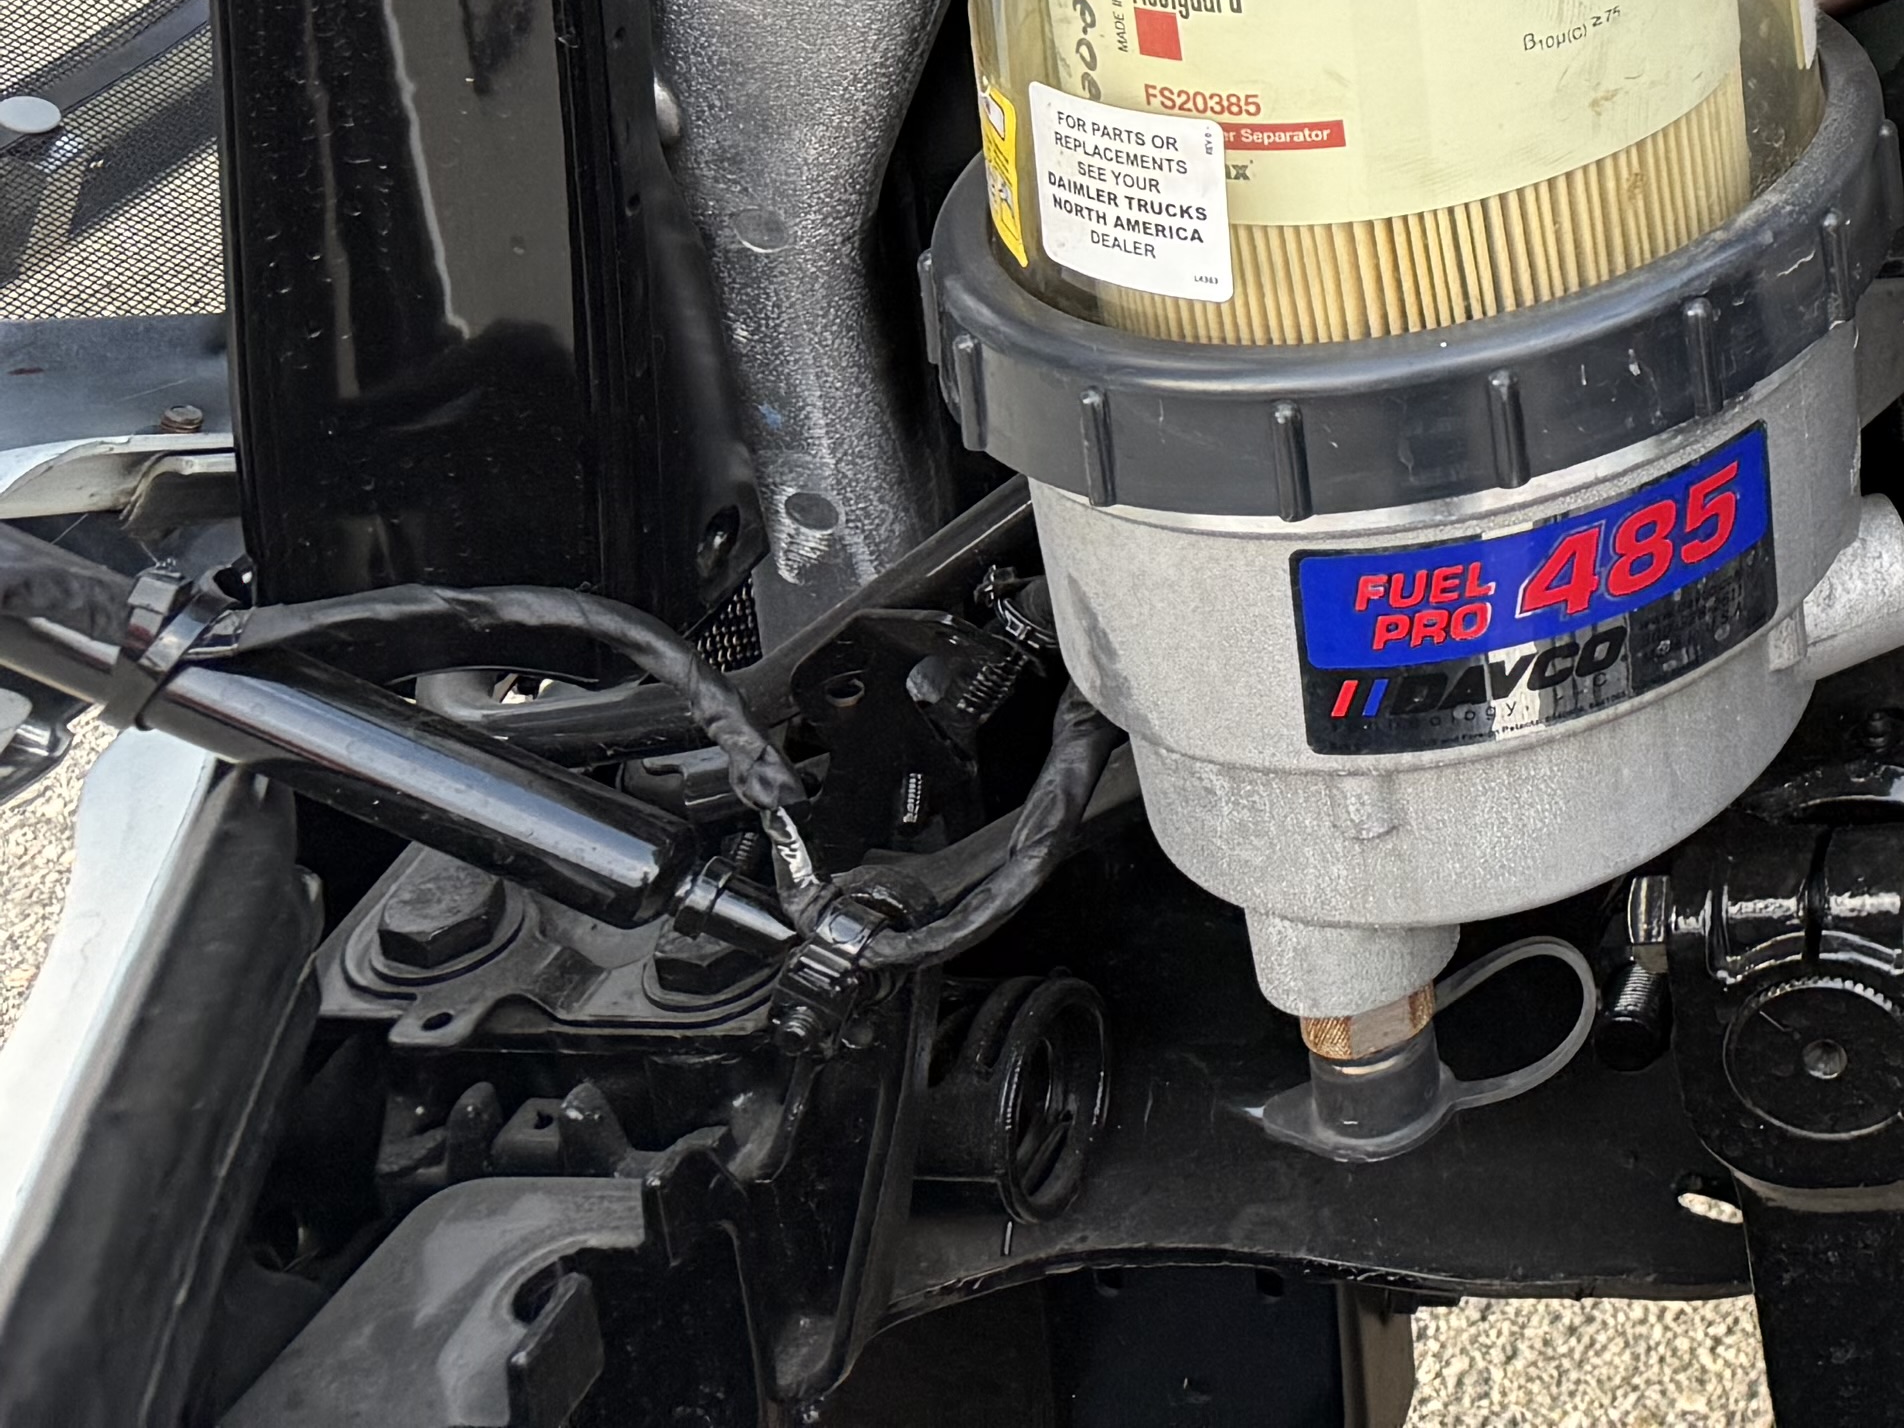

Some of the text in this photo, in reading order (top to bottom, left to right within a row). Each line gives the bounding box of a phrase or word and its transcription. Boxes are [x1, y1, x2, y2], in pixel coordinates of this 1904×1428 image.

[1114, 11, 1129, 53] MADE
[1143, 82, 1262, 117] FS20385
[1054, 131, 1189, 176] REPLACEMENTS
[1056, 110, 1179, 152] FOR PARTS OR
[1240, 127, 1331, 146] Separator
[1047, 170, 1208, 221] DAIMLER TRUCKS
[1077, 161, 1162, 194] SEE YOUR
[1052, 193, 1204, 244] NORTH AMERICA
[1089, 229, 1157, 259] DEALER
[1514, 459, 1740, 620] 485
[1354, 561, 1496, 614] FUEL
[1372, 601, 1493, 652] PRO
[1389, 624, 1628, 718] DAVCO
